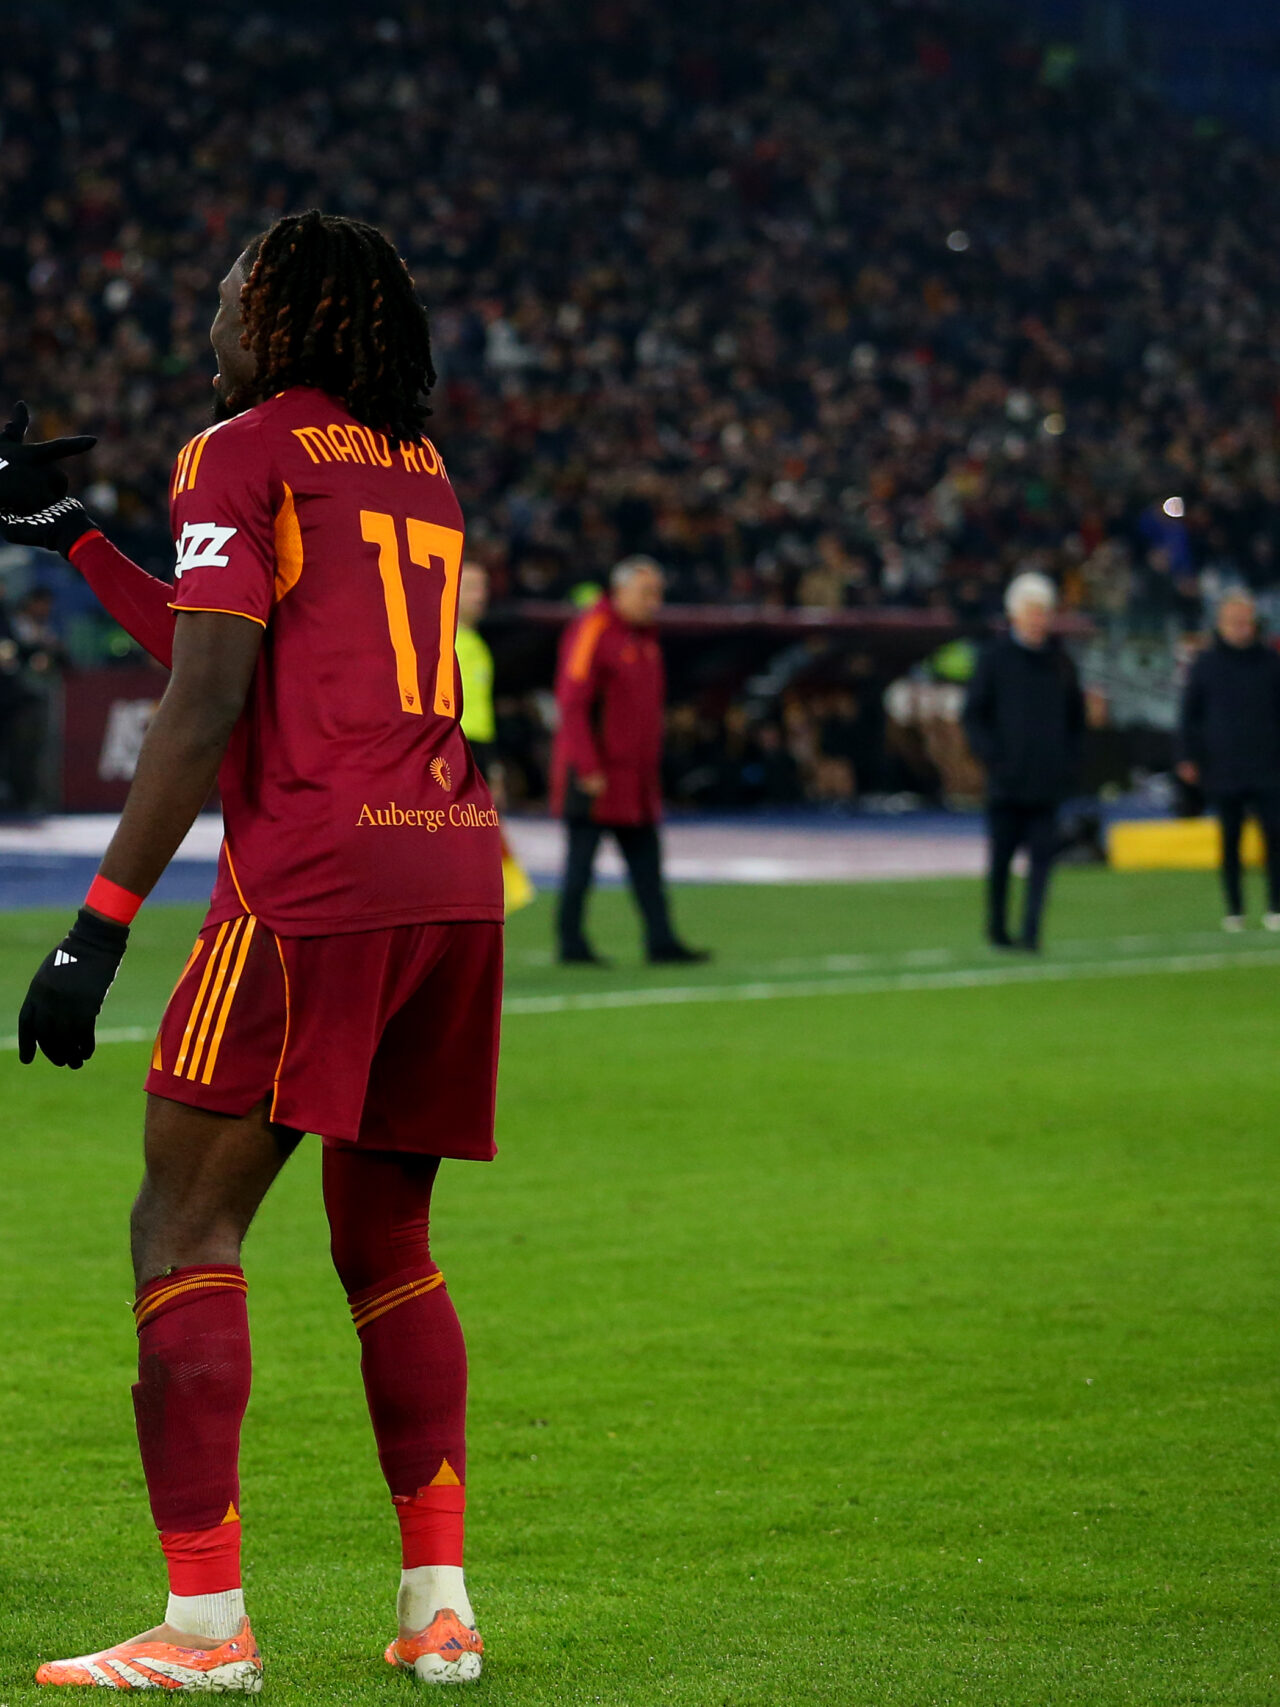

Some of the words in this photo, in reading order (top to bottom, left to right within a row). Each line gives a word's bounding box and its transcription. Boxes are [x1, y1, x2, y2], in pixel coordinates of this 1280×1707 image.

[291, 424, 393, 468] MANU
[359, 510, 463, 719] 17
[355, 802, 446, 832] Auberge
